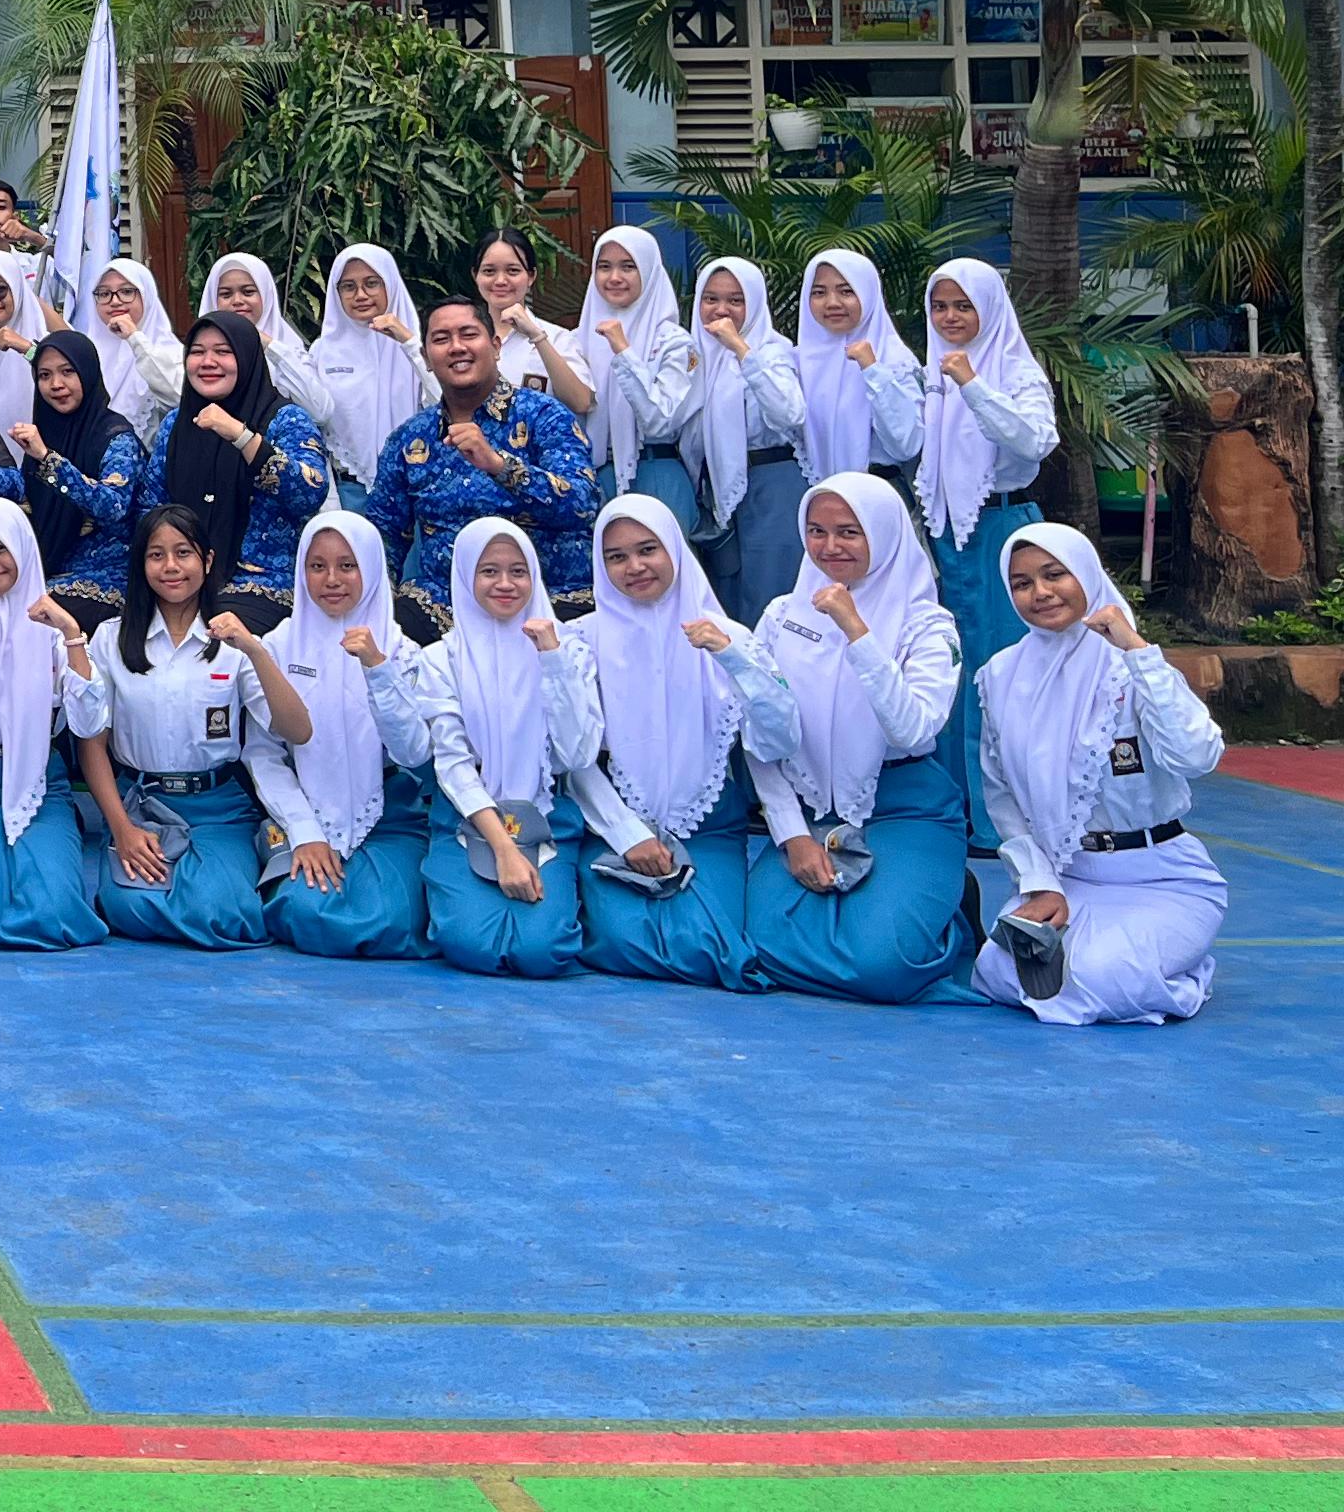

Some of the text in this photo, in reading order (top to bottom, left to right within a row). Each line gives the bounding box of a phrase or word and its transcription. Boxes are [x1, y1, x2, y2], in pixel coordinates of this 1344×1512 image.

[861, 0, 918, 13] JUARA 2
[985, 6, 1034, 20] JUARA
[993, 130, 1023, 148] JUA
[1084, 138, 1117, 147] BEST
[1080, 148, 1129, 158] PEAKER
